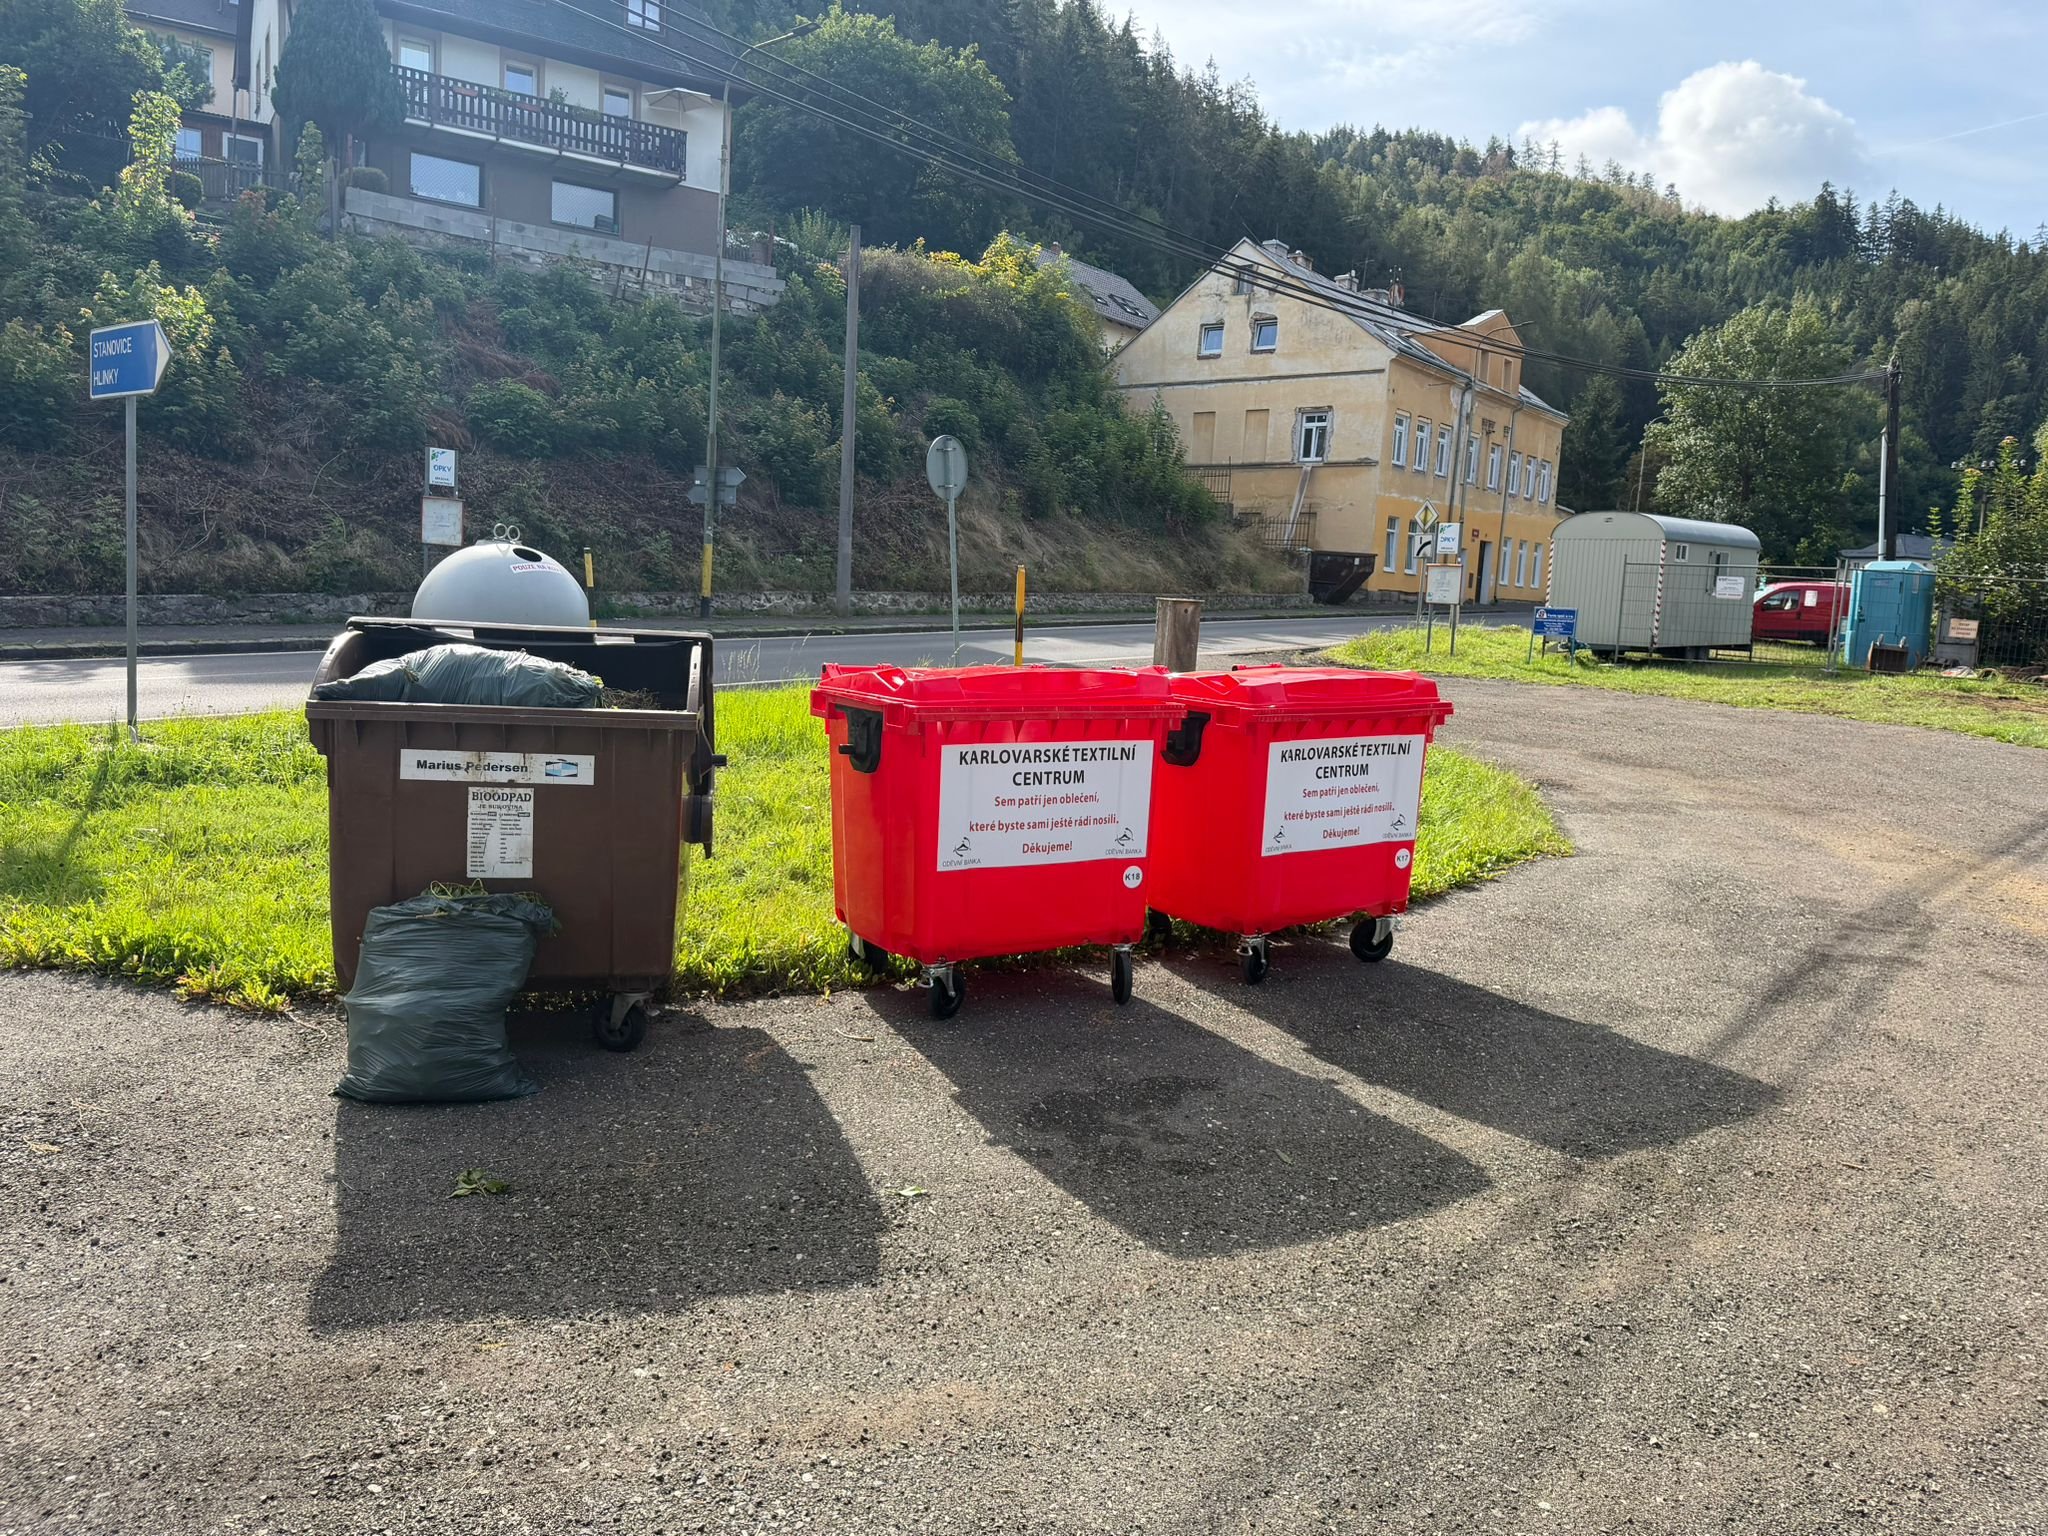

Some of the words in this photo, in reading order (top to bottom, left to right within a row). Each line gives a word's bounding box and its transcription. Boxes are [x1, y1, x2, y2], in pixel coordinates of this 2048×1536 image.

[93, 337, 132, 358] STANOVICE
[93, 368, 119, 386] HLINKY
[433, 464, 452, 473] OPKV
[959, 745, 1069, 765] KARLOVARSKÉ
[1072, 744, 1135, 762] TEXTILNÍ
[1280, 742, 1359, 763] KARLOVARSKÉ
[1360, 740, 1412, 757] TEXTILNÍ
[416, 759, 463, 770] Marius
[467, 761, 528, 773] Pedersen
[1315, 763, 1369, 779] CENTRUM
[1012, 770, 1085, 786] CENTRUM
[472, 791, 531, 802] BIOODPAD
[994, 796, 1016, 807] Sem
[1018, 794, 1041, 808] patří
[1043, 793, 1058, 807] jen
[1059, 792, 1100, 804] oblečení,
[1302, 788, 1318, 798] Sem
[1319, 786, 1337, 799] patří
[1337, 786, 1349, 797] jen
[1283, 811, 1304, 821] které
[1305, 809, 1325, 821] byste
[1326, 807, 1343, 817] sami
[1343, 806, 1361, 818] ještě
[1361, 803, 1374, 814] rádi
[969, 820, 995, 832] které
[998, 819, 1025, 833] byste
[1027, 818, 1049, 829] sami
[1050, 816, 1073, 830] ještě
[1074, 815, 1091, 827] rádi
[1092, 814, 1119, 826] nosili.
[1322, 826, 1360, 840] Děkujeme!
[1022, 841, 1073, 855] Děkujeme!
[1396, 854, 1409, 862] K17
[1124, 872, 1140, 881] K18
